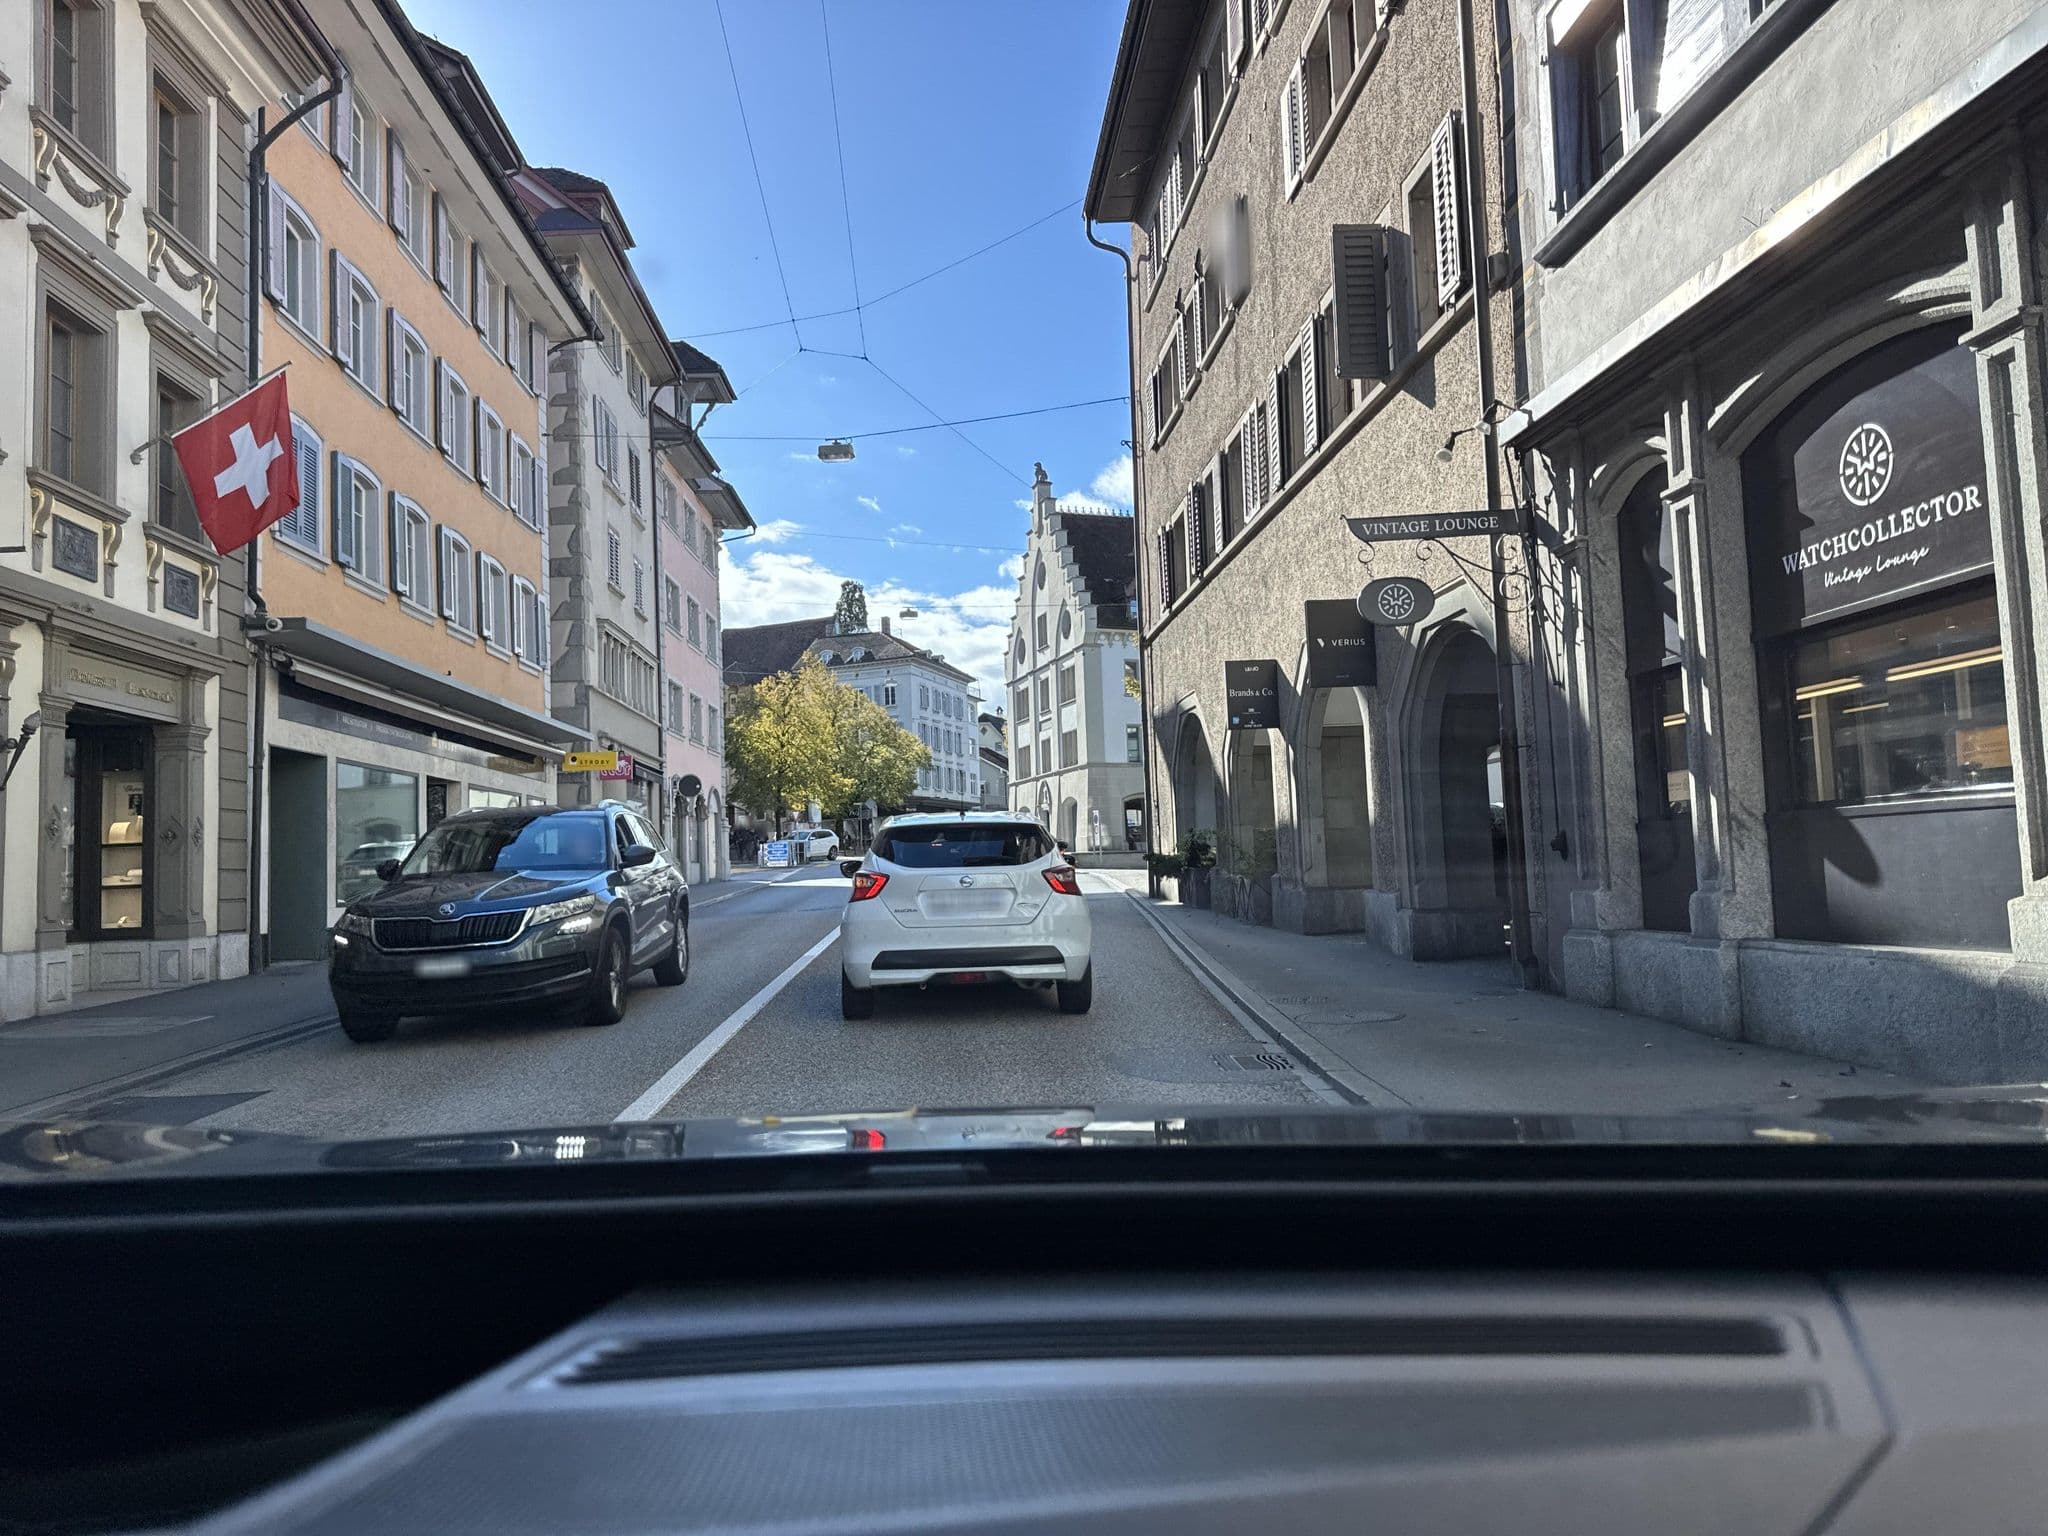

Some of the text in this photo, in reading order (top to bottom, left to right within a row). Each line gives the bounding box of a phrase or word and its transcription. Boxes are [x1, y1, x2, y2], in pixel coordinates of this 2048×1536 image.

[1362, 516, 1499, 536] VINTAGE LOUNGE
[1782, 485, 1982, 576] WATCHCOLLECTOR
[1823, 546, 1930, 588] Vintage Lounge
[1331, 638, 1366, 647] VERIUS
[1229, 688, 1254, 697] Brands
